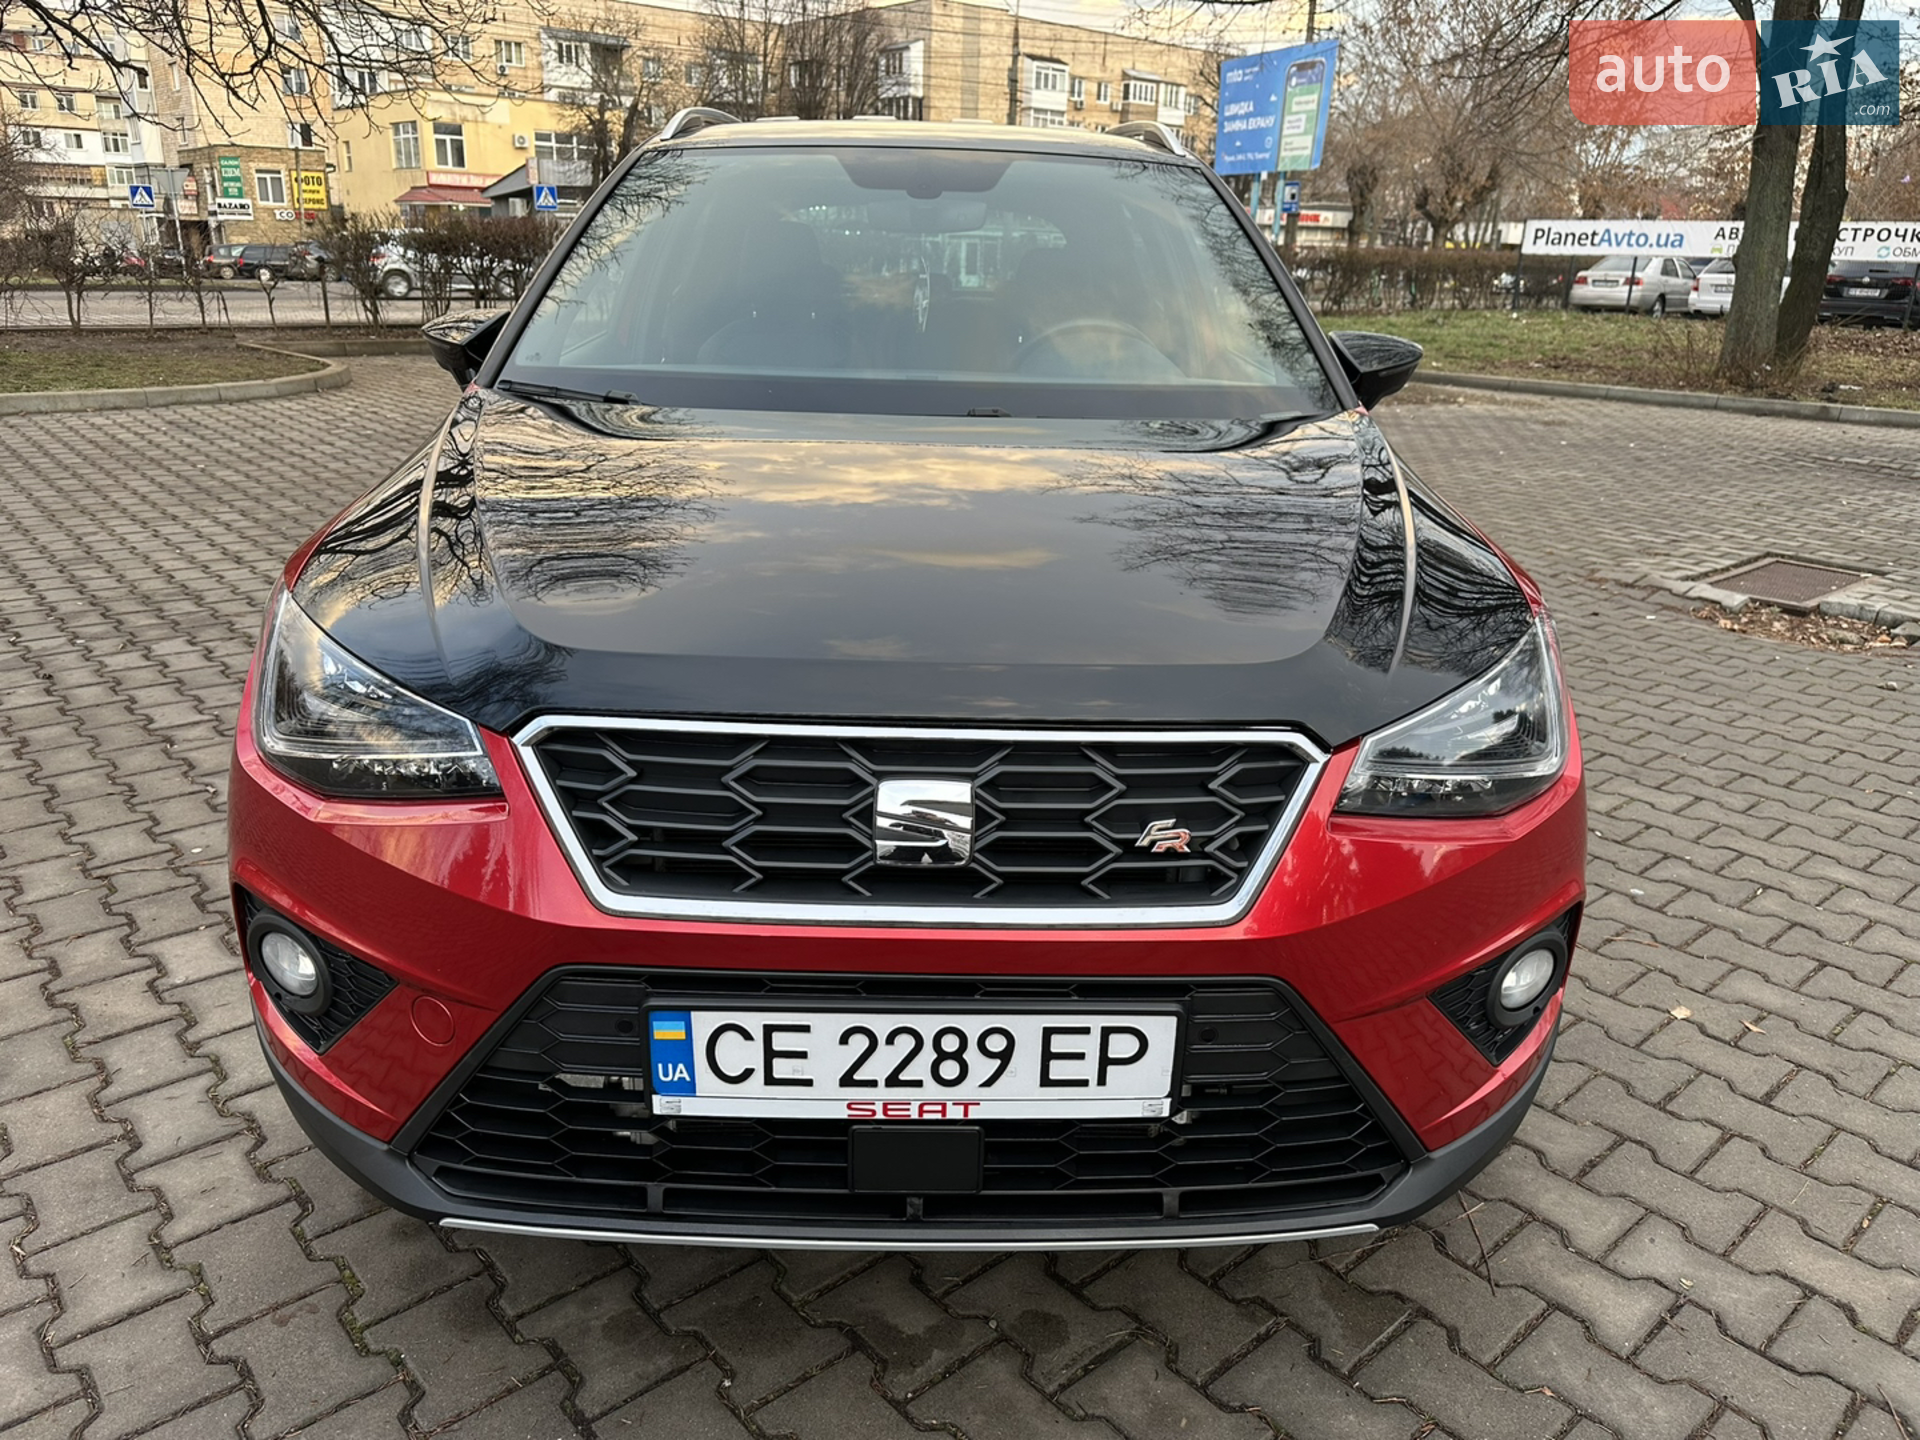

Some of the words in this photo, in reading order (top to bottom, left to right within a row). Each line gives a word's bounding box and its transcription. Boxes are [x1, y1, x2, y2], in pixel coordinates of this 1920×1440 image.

[1224, 100, 1254, 117] ШВИДКА
[1532, 227, 1685, 249] PlanetAvto.ua
[1836, 227, 1920, 243] СТРОЧК
[705, 1022, 814, 1087] CE
[838, 1025, 1016, 1088] 2289
[1039, 1025, 1149, 1088] EP
[657, 1063, 691, 1082] UA
[846, 1101, 981, 1119] SEAT
